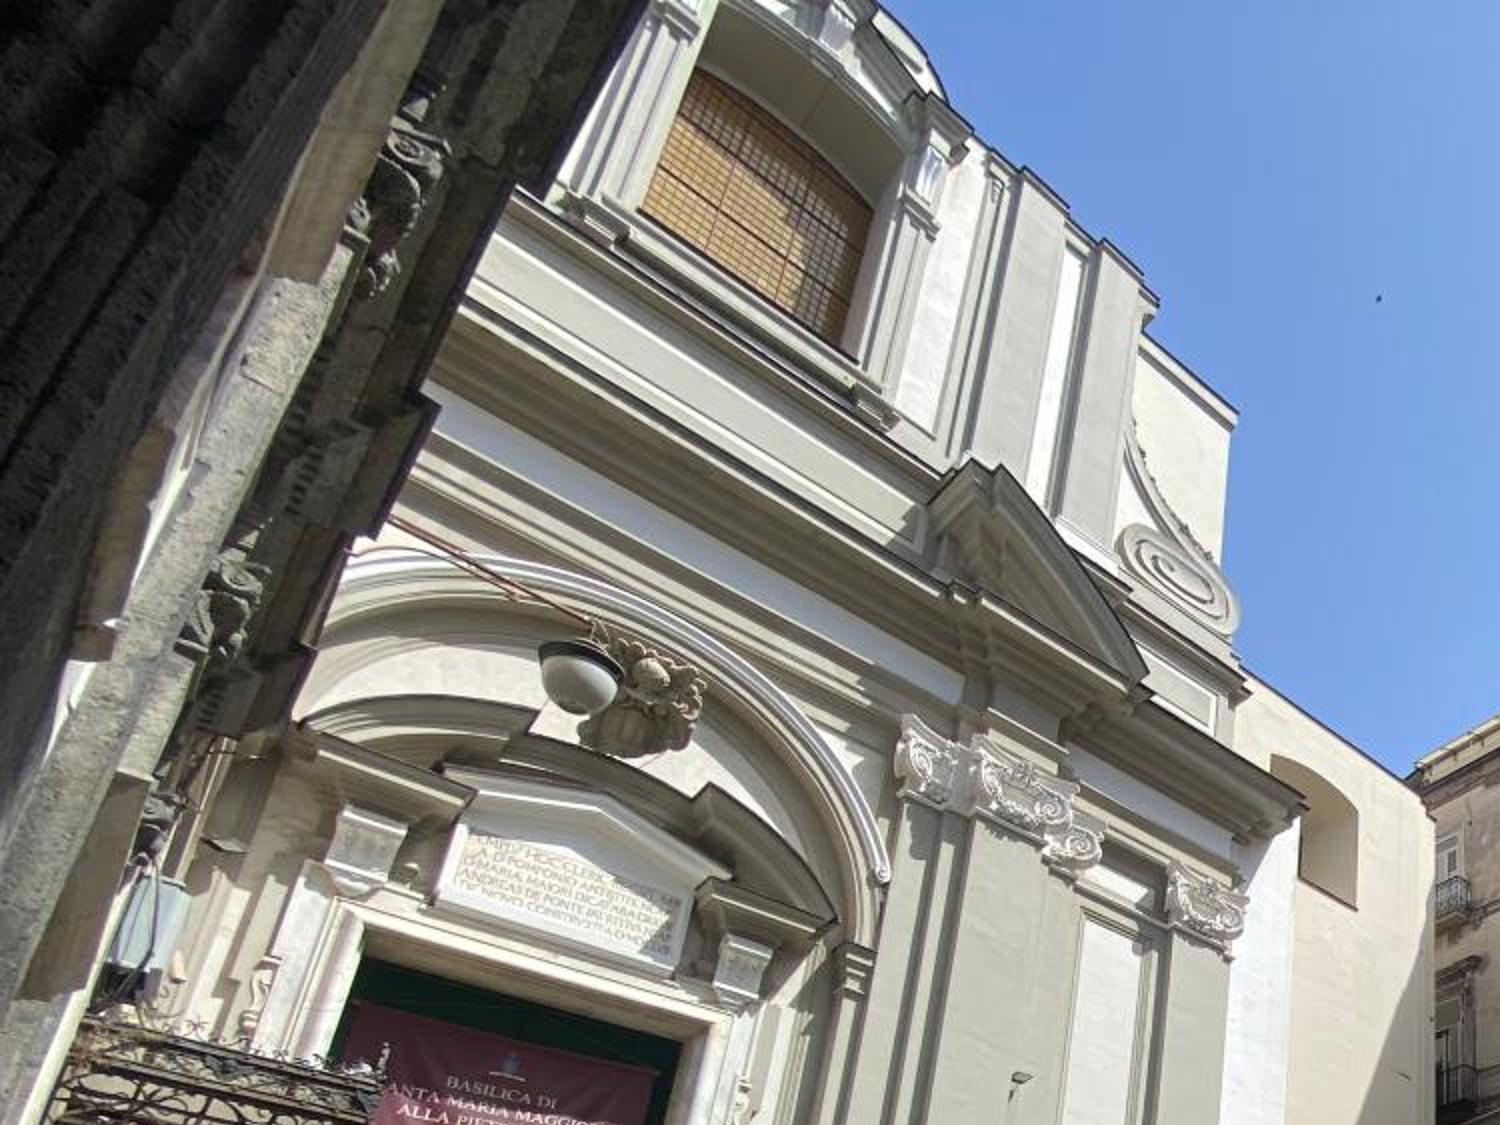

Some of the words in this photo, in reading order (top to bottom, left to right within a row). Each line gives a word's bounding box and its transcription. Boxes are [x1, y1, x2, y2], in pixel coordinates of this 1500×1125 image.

[388, 1082, 442, 1105] ANTA
[446, 1096, 510, 1119] MARIA
[446, 1074, 531, 1106] BASILICA
[536, 1096, 557, 1110] DI
[397, 1103, 450, 1125] ALLA
